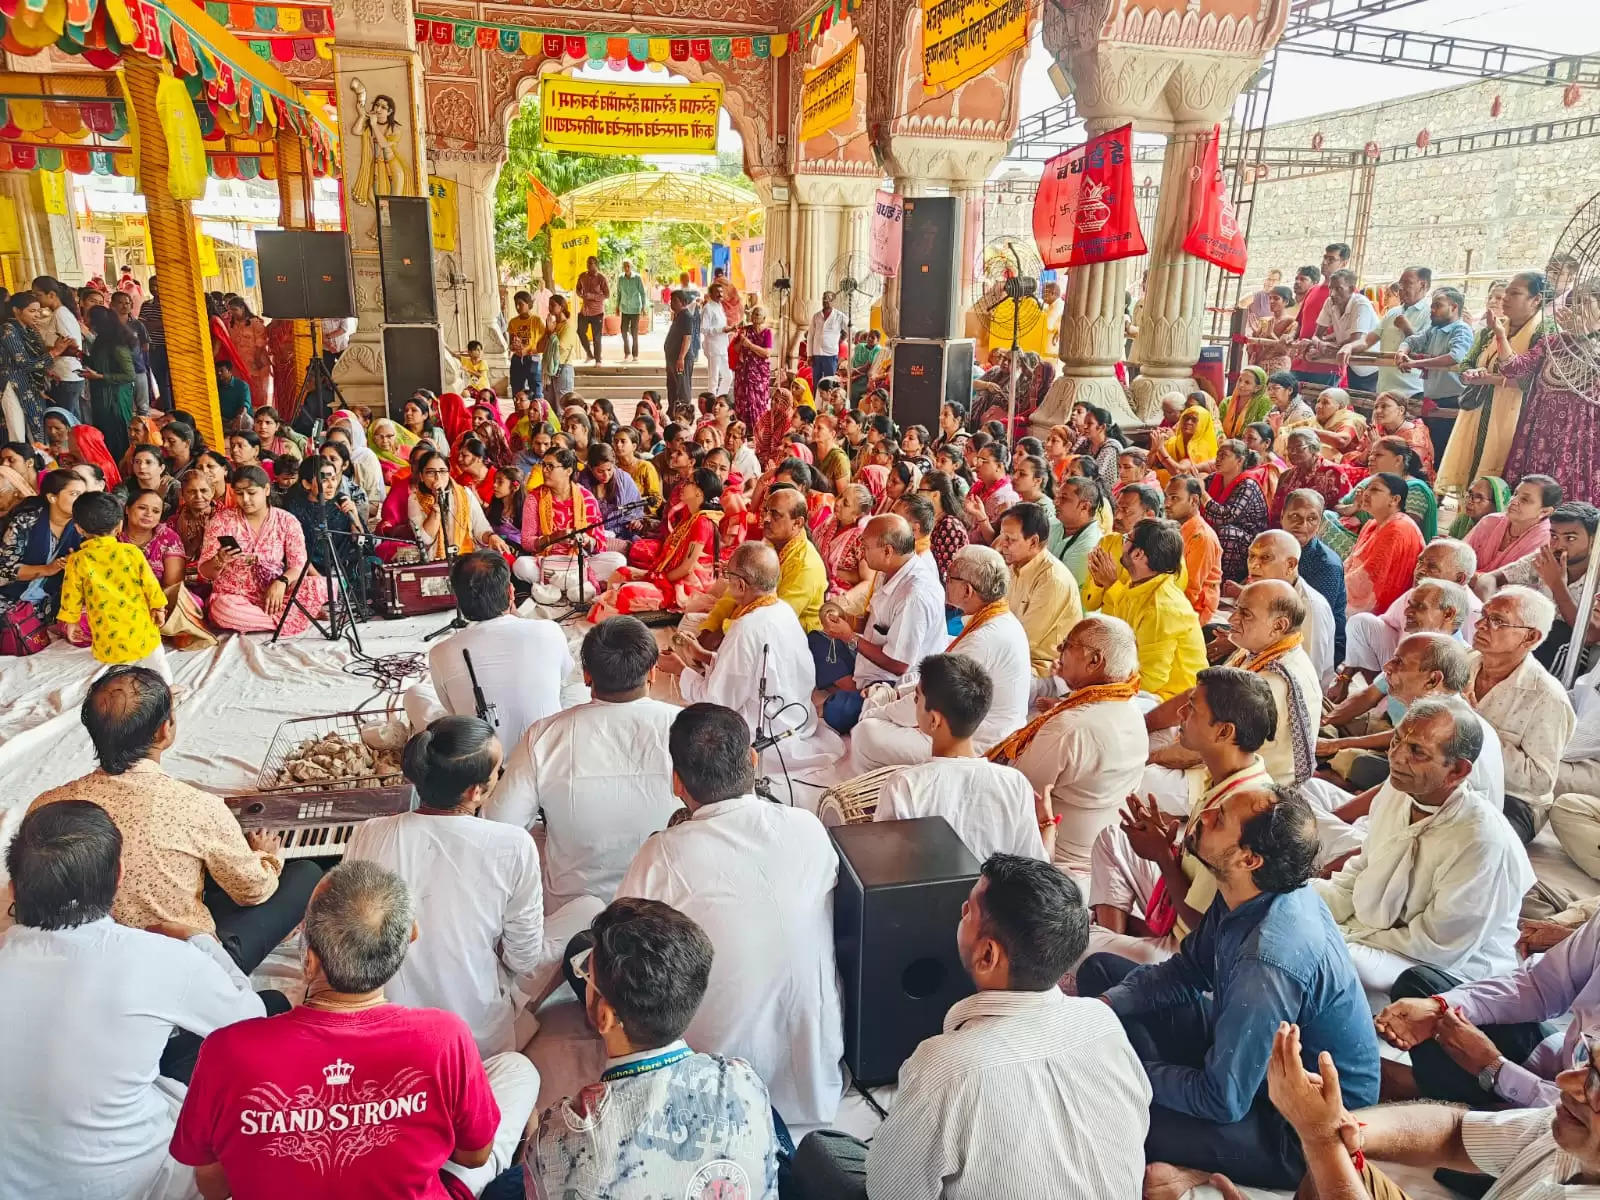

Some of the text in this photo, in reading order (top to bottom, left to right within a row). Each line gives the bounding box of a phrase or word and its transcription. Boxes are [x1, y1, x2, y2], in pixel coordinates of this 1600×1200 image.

[636, 1060, 663, 1073] Hare
[240, 1091, 428, 1135] STAND STRONG
